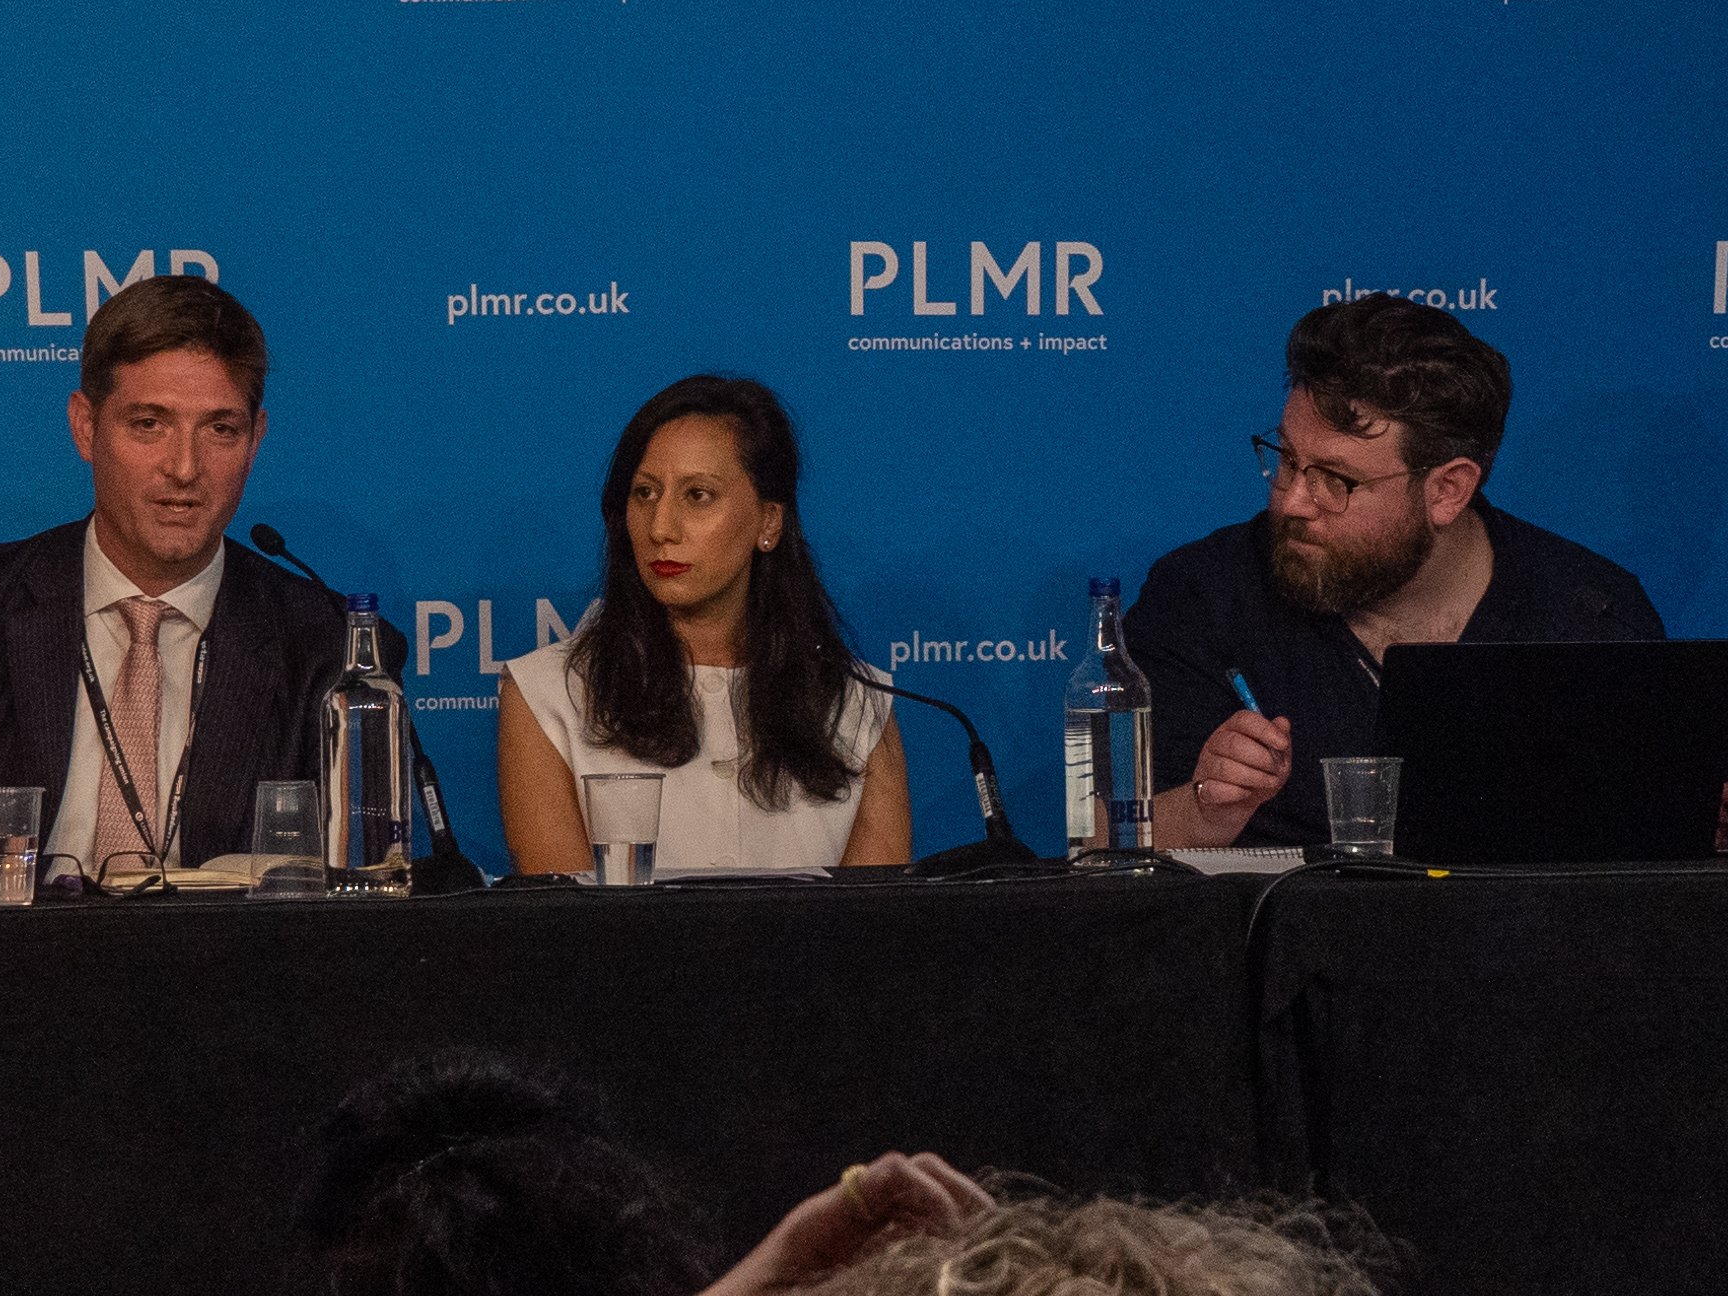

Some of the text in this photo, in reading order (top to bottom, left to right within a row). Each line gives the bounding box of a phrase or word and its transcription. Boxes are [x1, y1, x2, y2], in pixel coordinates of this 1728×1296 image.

[849, 241, 1105, 317] PLMR
[447, 281, 630, 326] plmr.co.uk
[847, 332, 1107, 355] communications + impact
[889, 628, 1069, 671] plmr.co.uk
